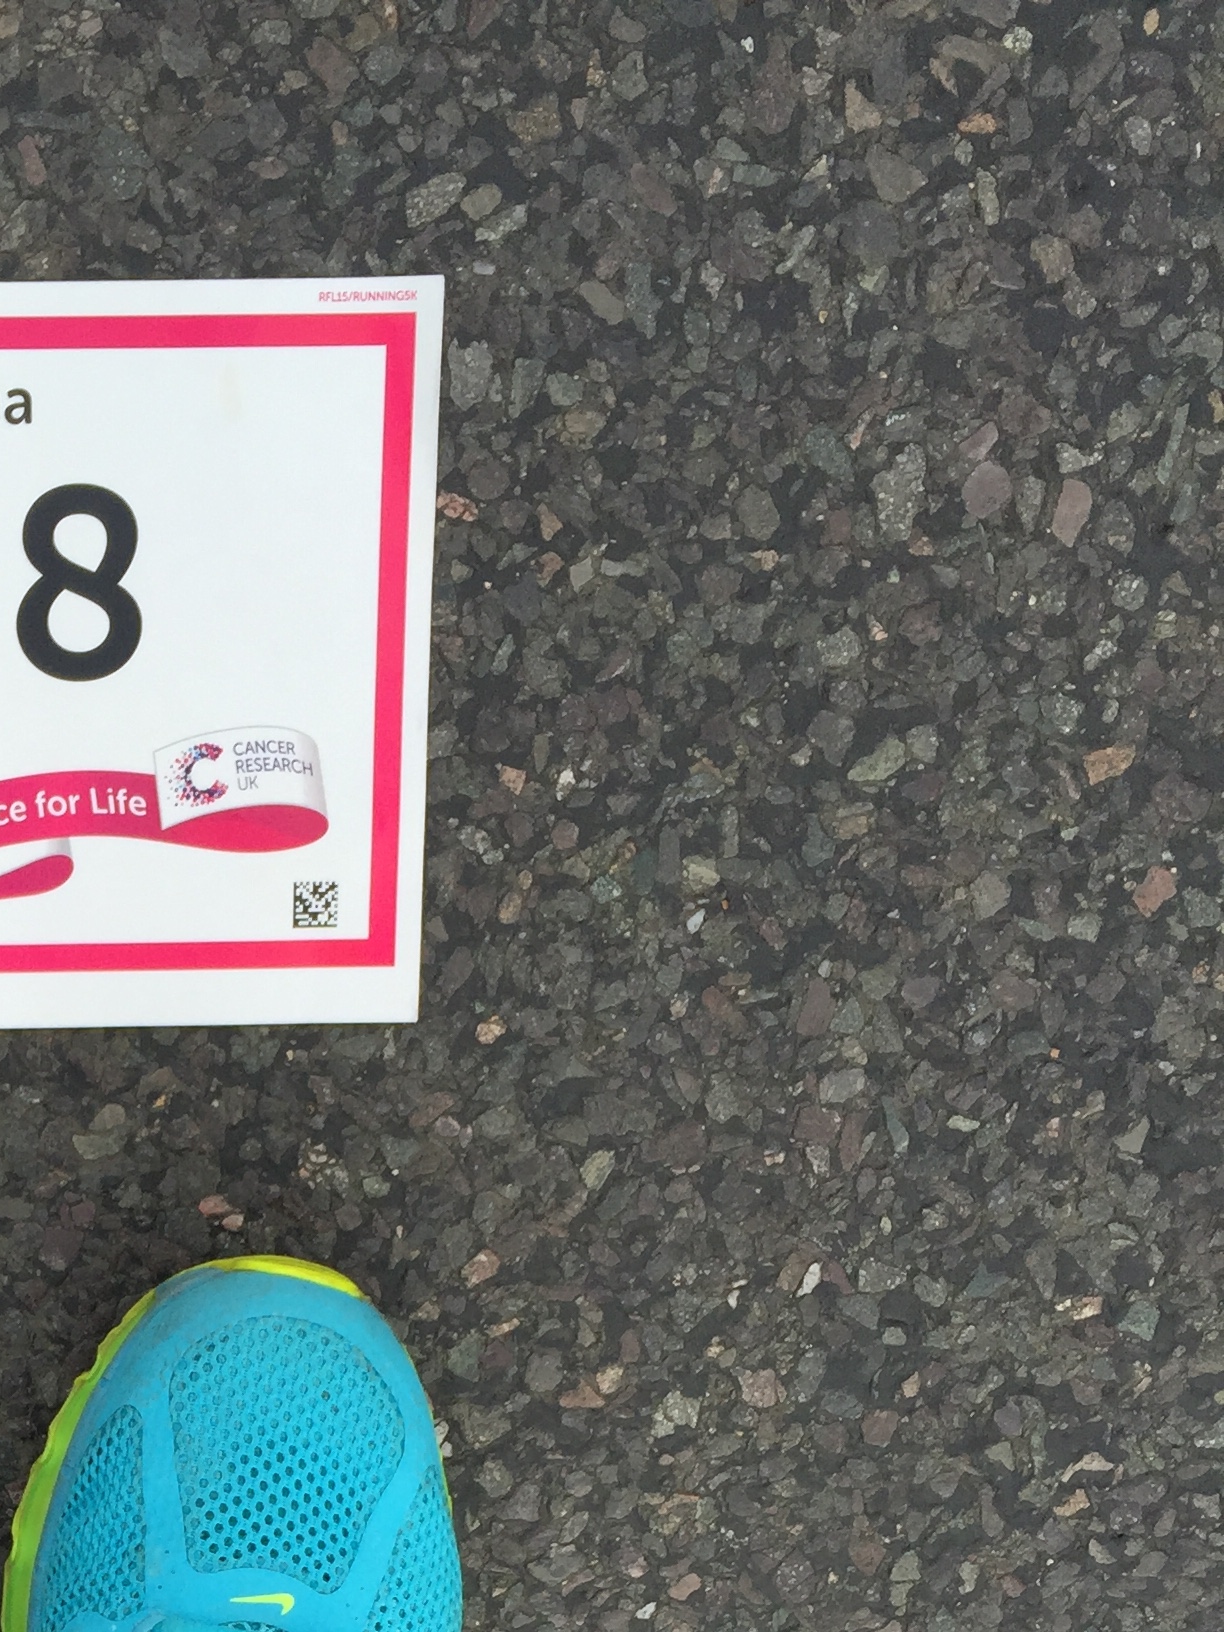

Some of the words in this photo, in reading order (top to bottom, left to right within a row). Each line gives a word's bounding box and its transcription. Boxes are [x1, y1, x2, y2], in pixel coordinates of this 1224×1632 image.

[232, 739, 296, 760] CANCER
[235, 758, 314, 777] RESEARCH
[237, 775, 259, 791] UK
[35, 790, 80, 819] for
[89, 787, 147, 816] Life
